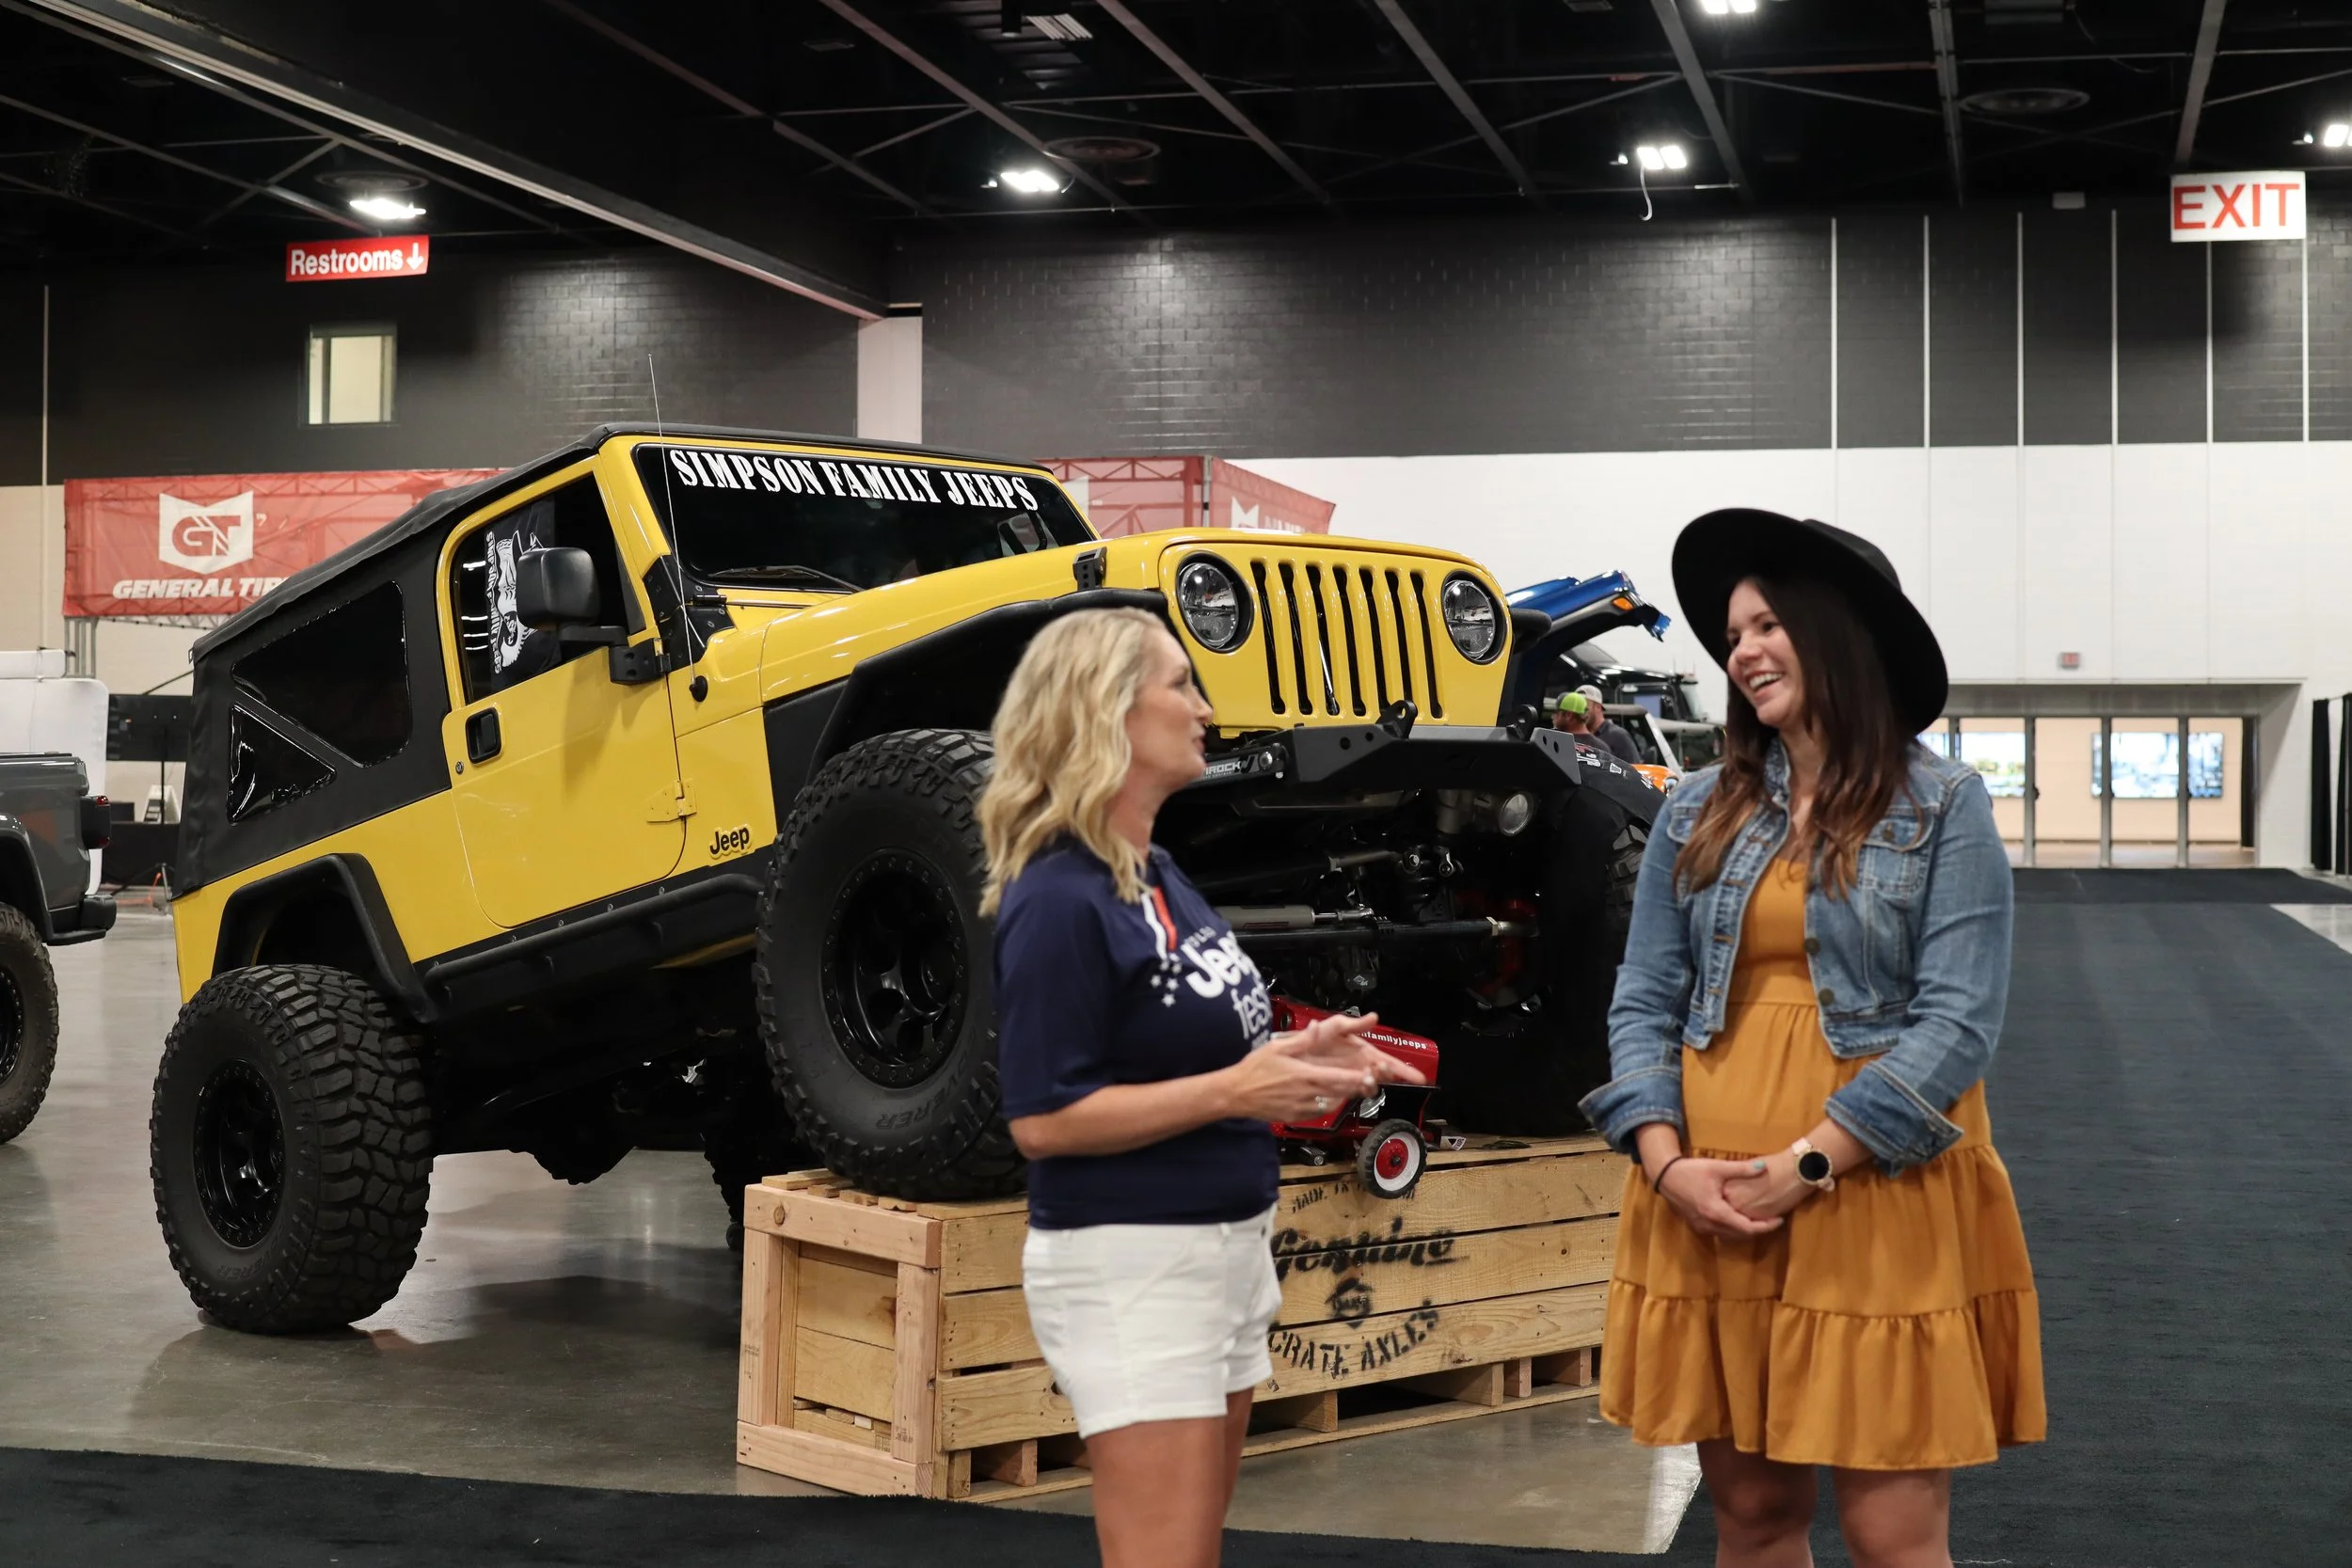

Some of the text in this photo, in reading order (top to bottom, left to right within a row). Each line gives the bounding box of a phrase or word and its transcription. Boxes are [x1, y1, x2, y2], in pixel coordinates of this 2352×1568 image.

[2174, 183, 2300, 230] EXIT
[291, 248, 404, 276] Restrooms
[669, 449, 1039, 512] SIMPSON FAMILY JEEPS
[112, 576, 290, 599] GENERAL TIR
[1203, 760, 1242, 776] IROCK
[709, 827, 750, 855] Jeep
[1268, 1330, 1351, 1380] CRATE
